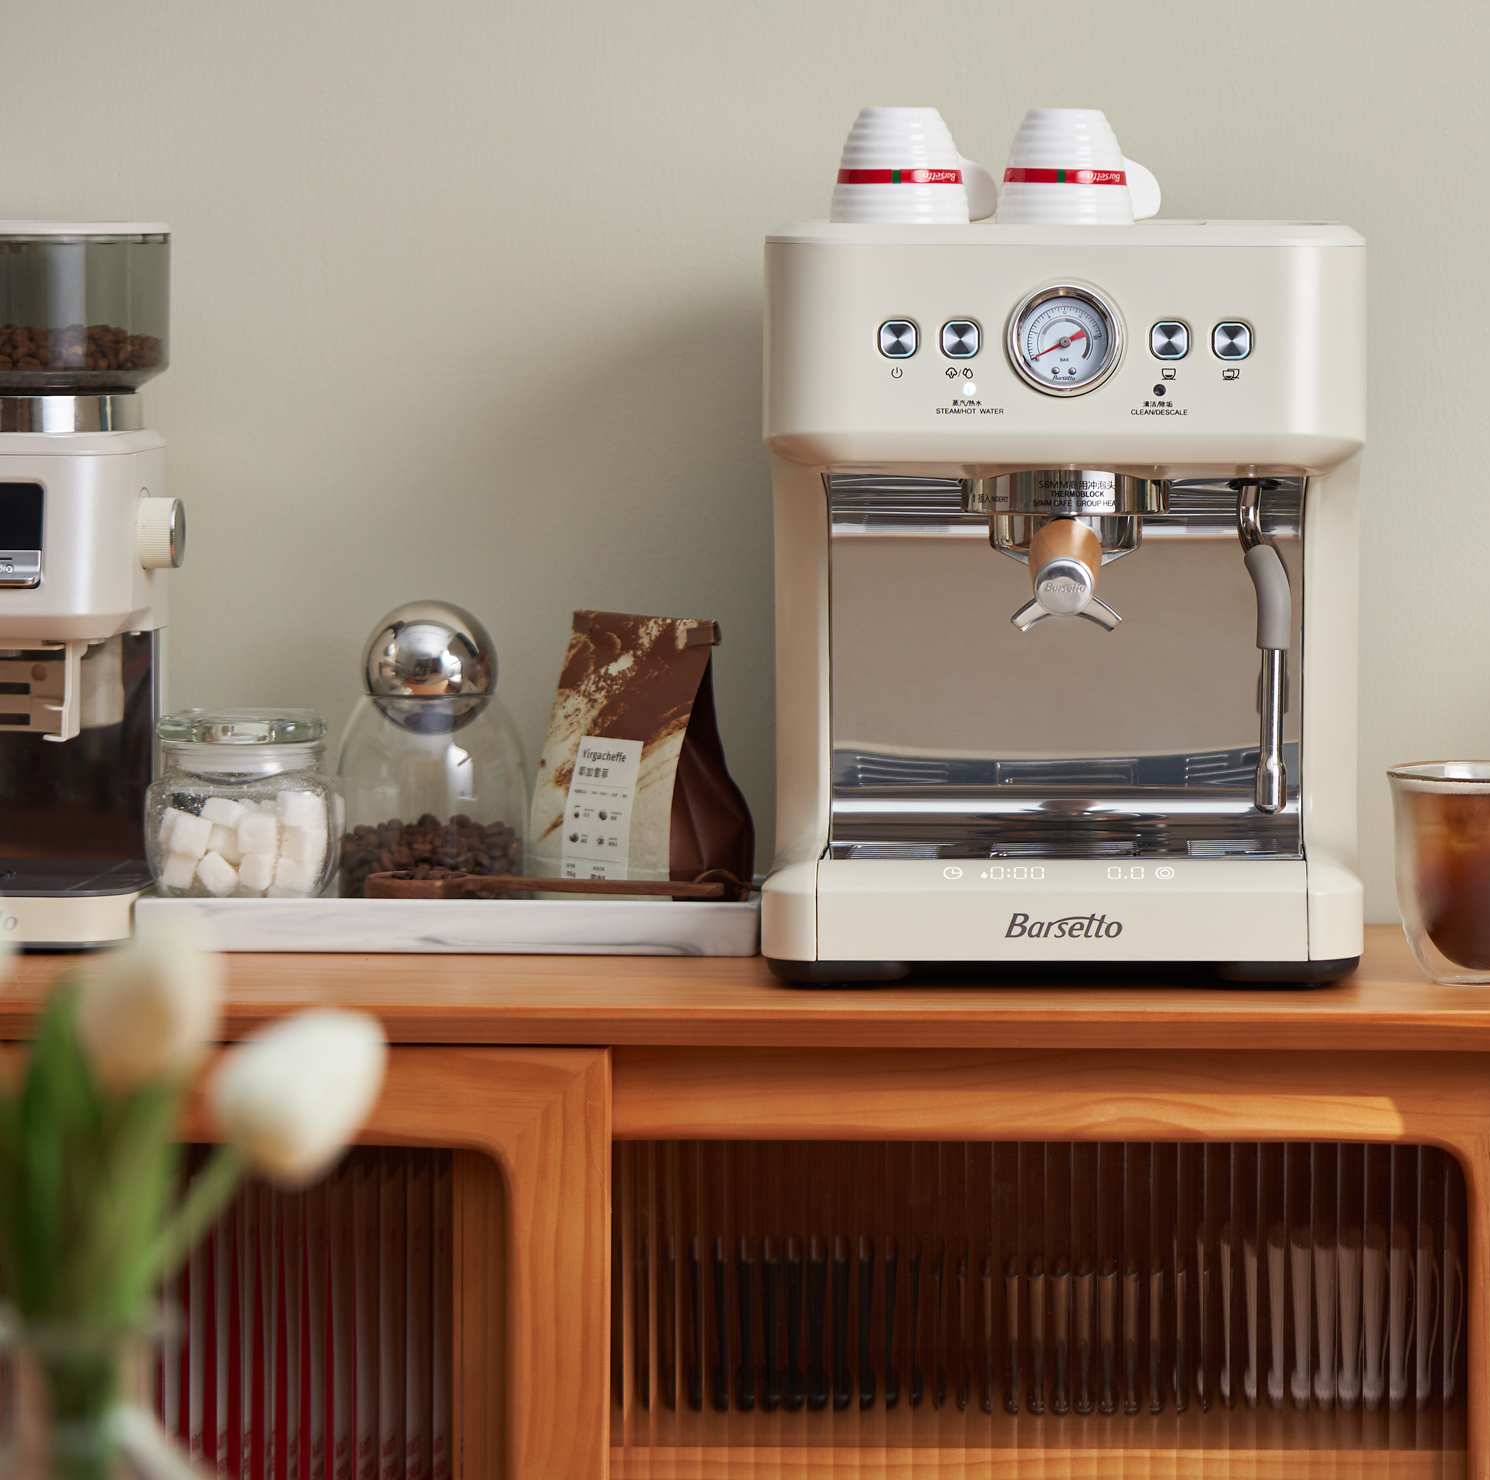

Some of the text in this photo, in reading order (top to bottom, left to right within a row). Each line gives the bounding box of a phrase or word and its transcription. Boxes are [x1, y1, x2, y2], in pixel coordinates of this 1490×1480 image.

[922, 172, 956, 181] Barsetto
[1087, 172, 1121, 183] Barsetto
[1044, 582, 1086, 593] Barsetto
[583, 749, 627, 762] Yirgacheffe
[990, 867, 1045, 880] 0:00
[1107, 867, 1144, 880] 0.0
[1005, 913, 1123, 939] Barsetto
